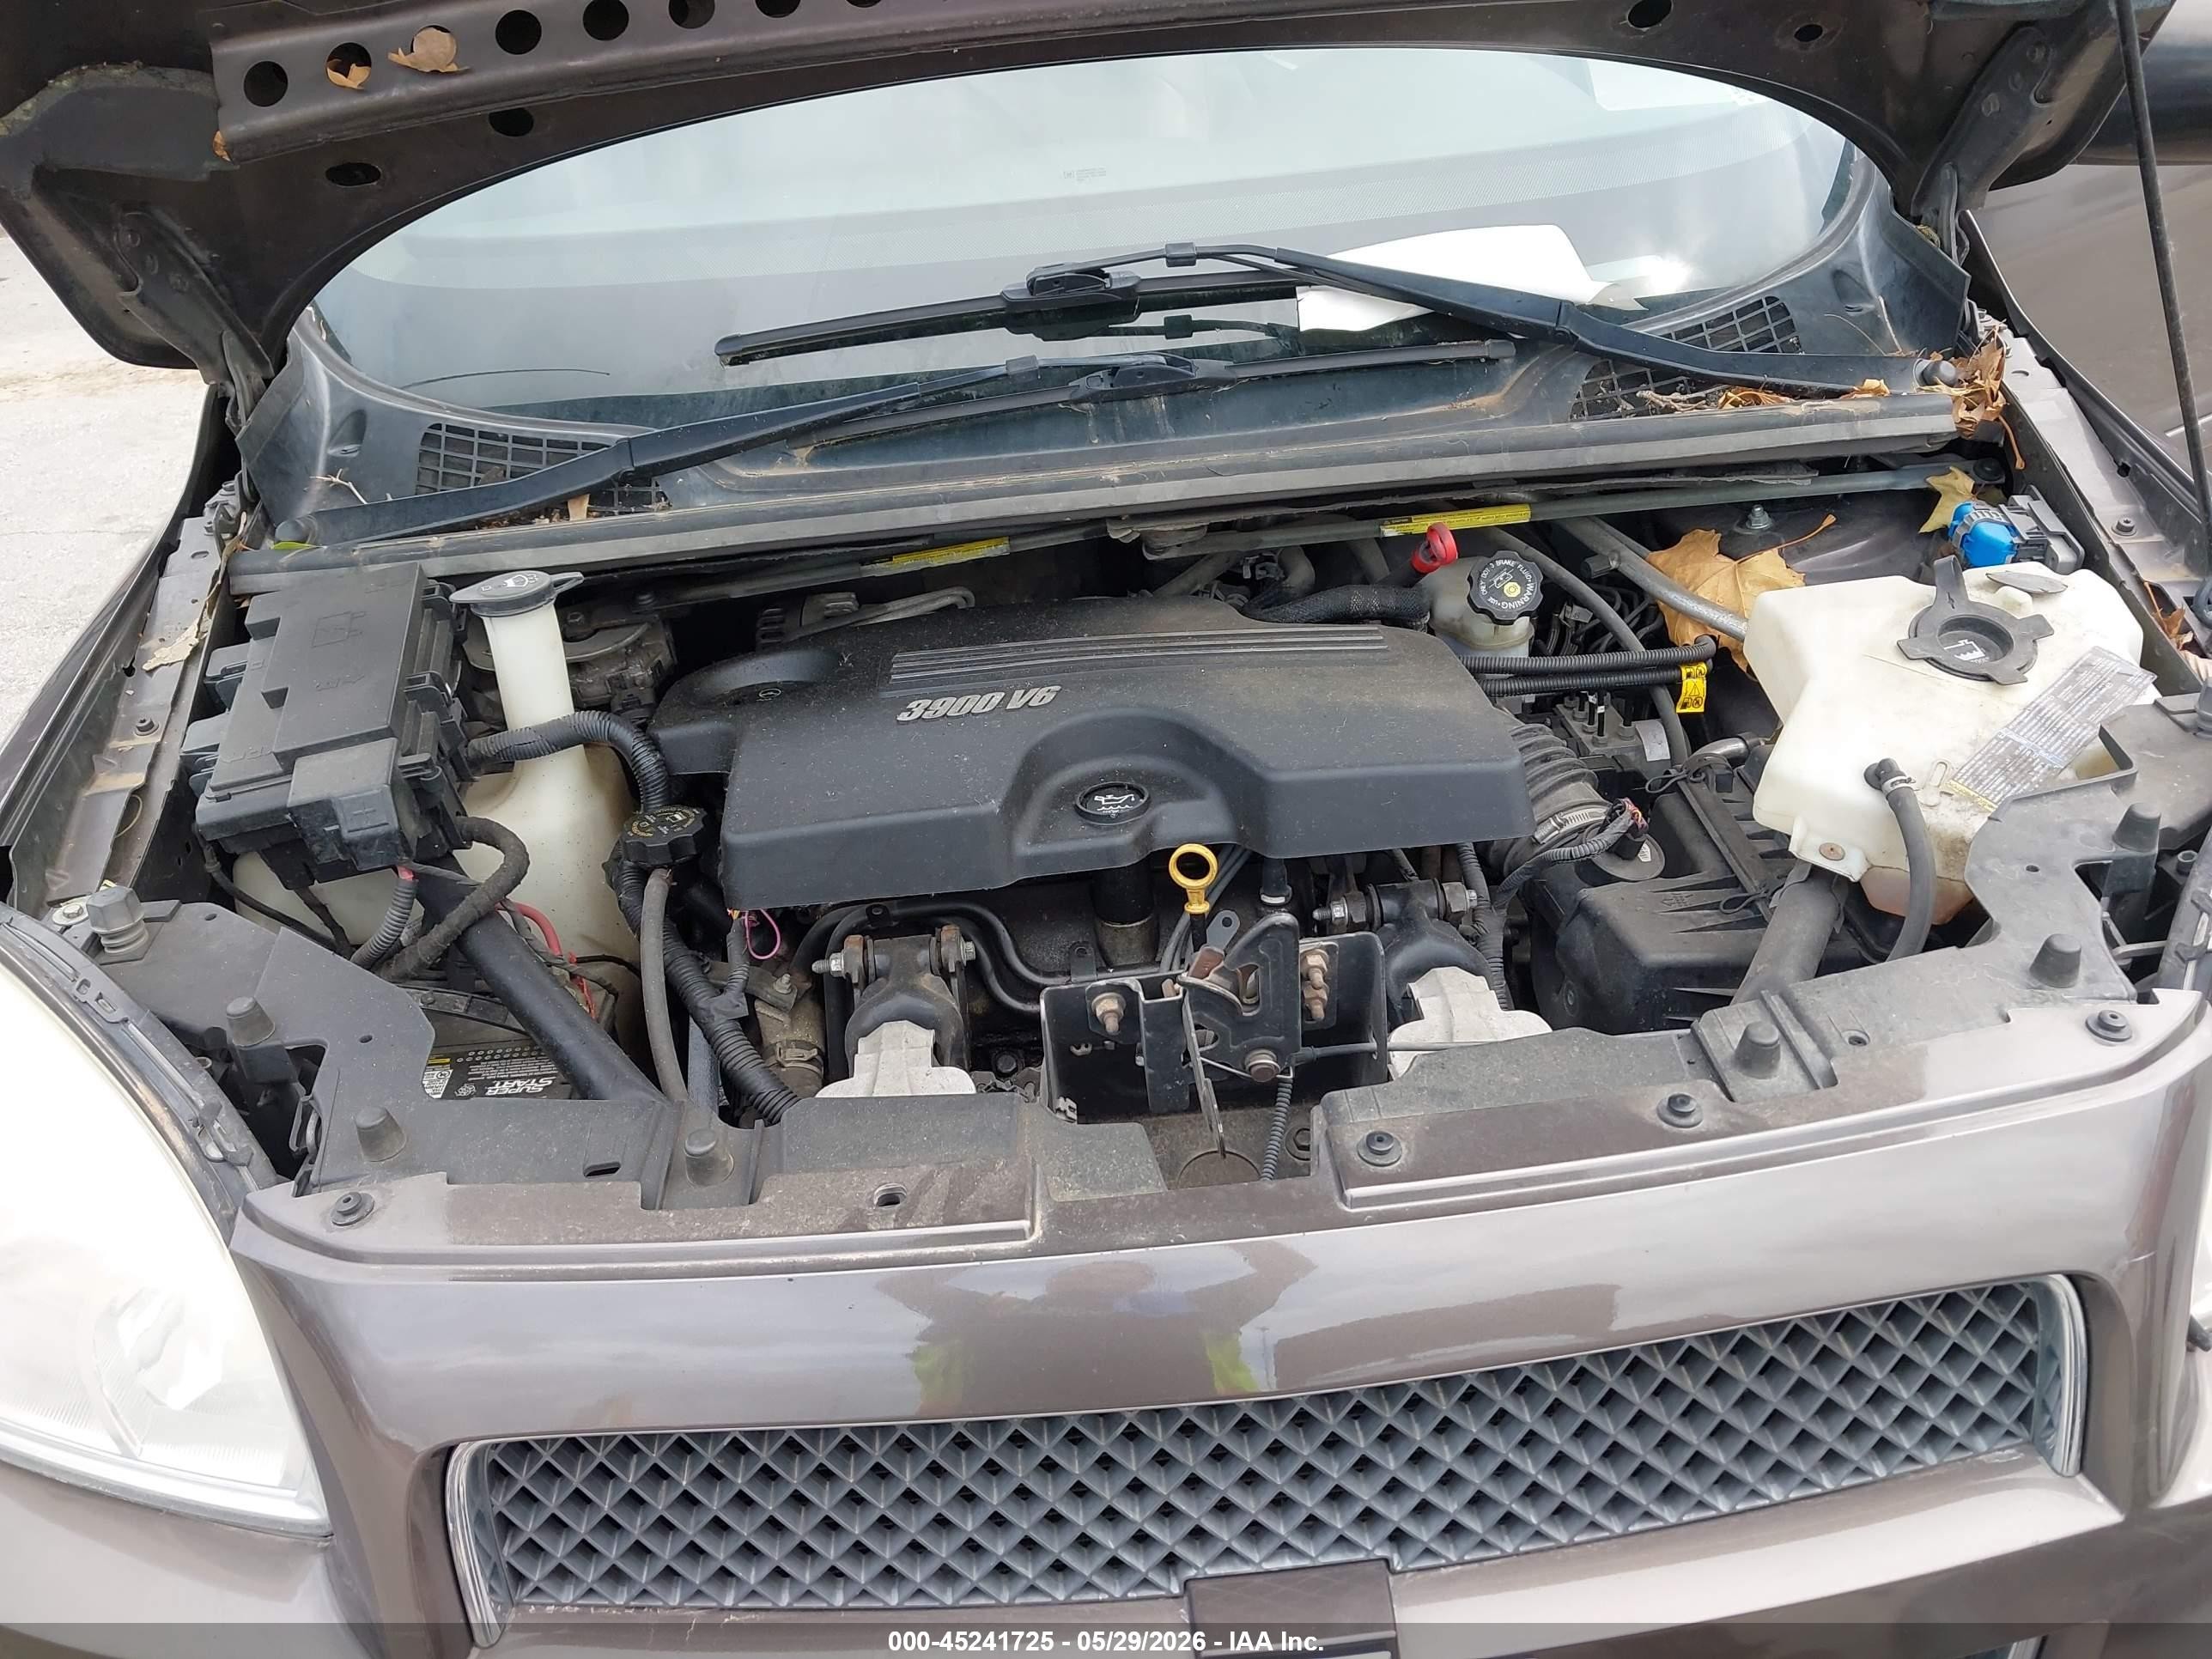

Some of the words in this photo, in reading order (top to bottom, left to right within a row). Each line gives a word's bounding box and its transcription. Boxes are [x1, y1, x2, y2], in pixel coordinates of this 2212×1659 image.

[1495, 559, 1516, 568] BRAKE
[1481, 568, 1491, 579] DOT
[1516, 564, 1533, 580] FLUID
[1501, 582, 1534, 609] WARNING
[896, 691, 1006, 721] 3900
[1006, 685, 1062, 710] V6
[492, 1076, 557, 1089] START
[485, 1085, 544, 1097] SUPER
